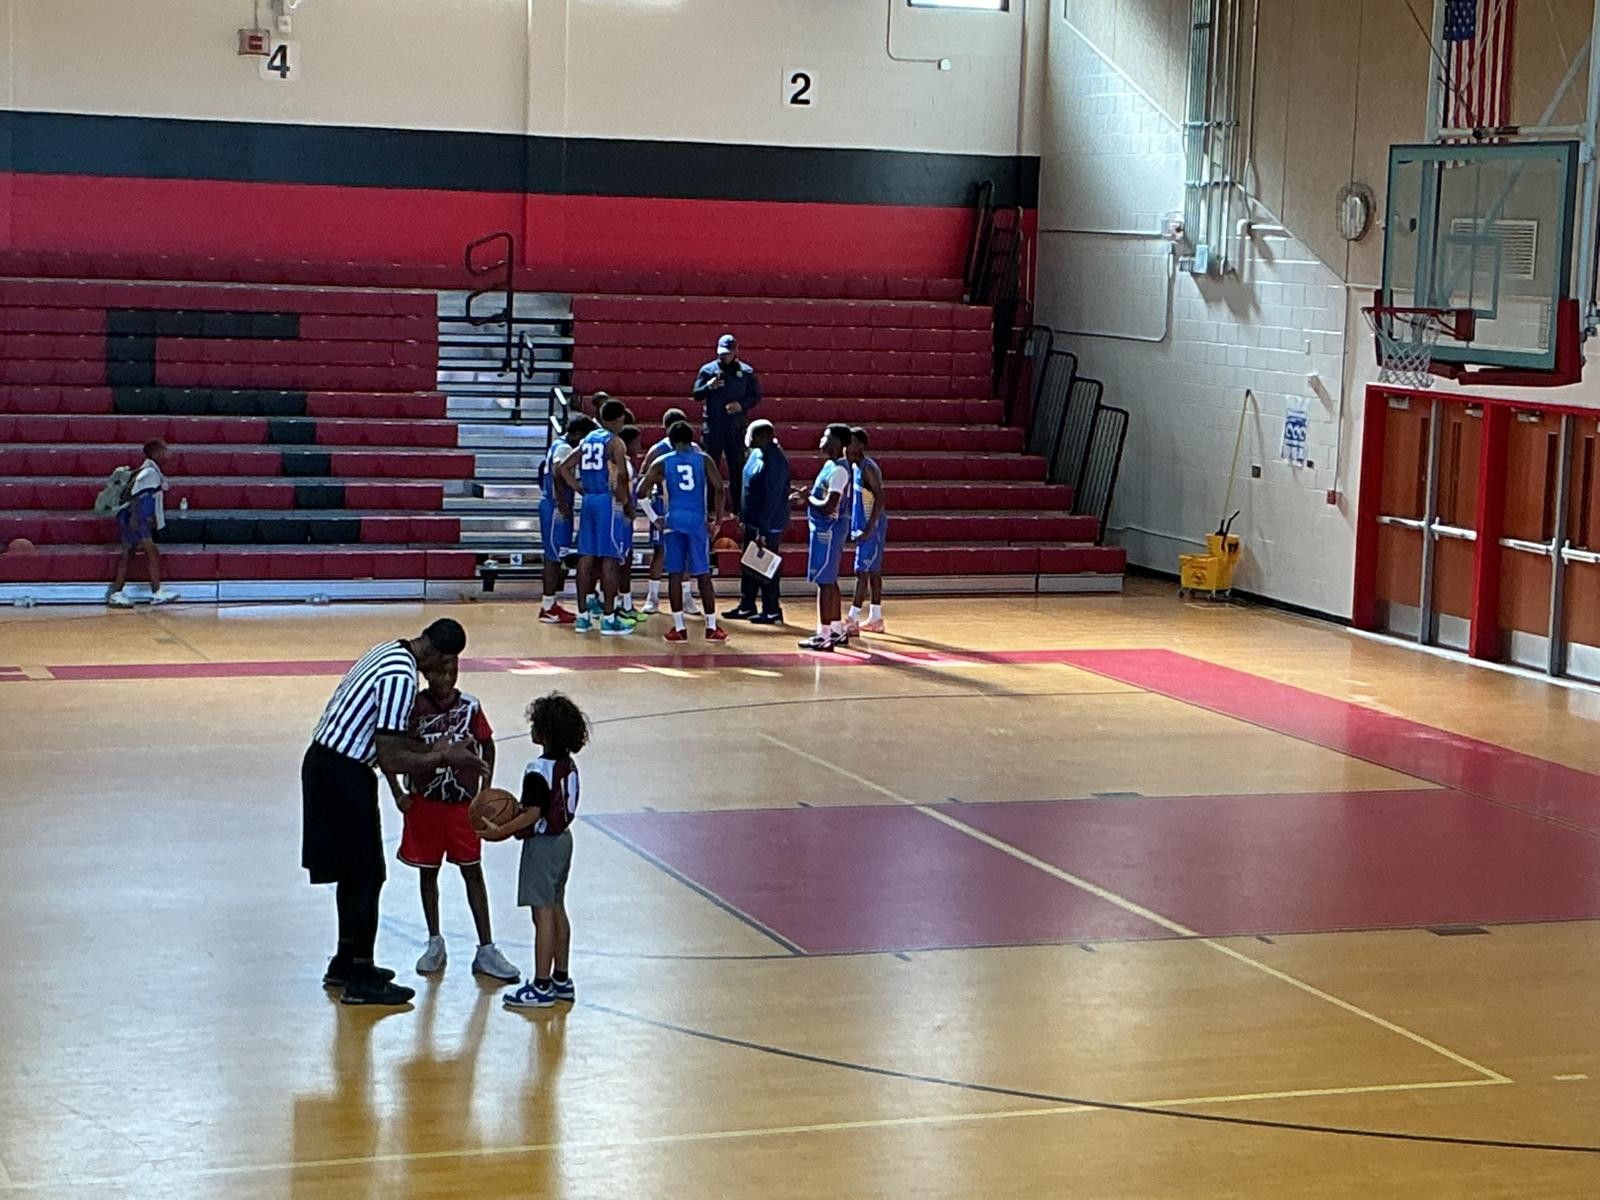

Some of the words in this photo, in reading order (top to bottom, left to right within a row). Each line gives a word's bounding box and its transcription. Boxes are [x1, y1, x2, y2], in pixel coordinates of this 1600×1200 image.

[267, 44, 291, 79] 4
[790, 72, 811, 105] 2
[581, 442, 605, 471] 23
[677, 464, 695, 491] 3
